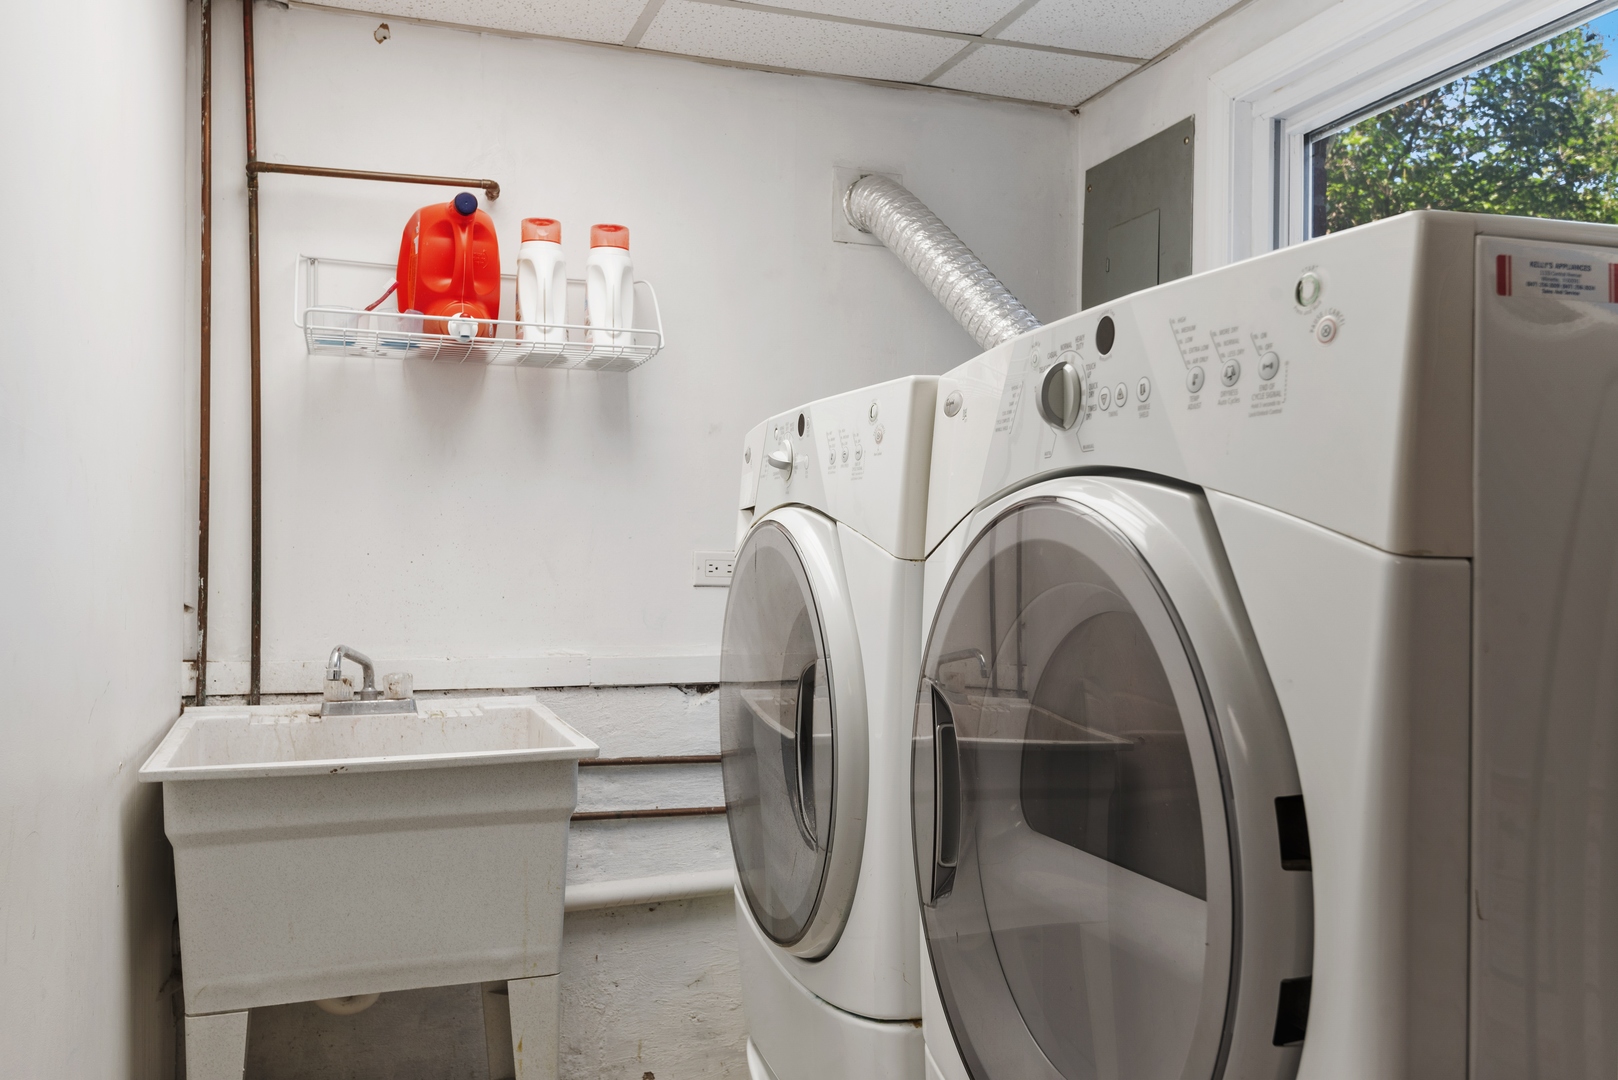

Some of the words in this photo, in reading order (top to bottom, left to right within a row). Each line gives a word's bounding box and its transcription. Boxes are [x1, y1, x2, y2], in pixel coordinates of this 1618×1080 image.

[1530, 261, 1554, 270] KELLY'S
[1555, 262, 1592, 272] APPLIANCES
[1181, 324, 1196, 333] MEDIUM
[1219, 327, 1231, 336] MORE
[1060, 341, 1073, 351] NORMAL
[1188, 346, 1200, 354] EXTRA
[1085, 362, 1097, 371] TOUCH
[1088, 382, 1099, 391] QUICK
[1258, 383, 1268, 392] END
[1220, 388, 1238, 398] DRYNESS
[1251, 392, 1265, 401] CYCLE
[1265, 390, 1283, 399] SIGNAL
[1087, 403, 1098, 412] TIMED
[1187, 402, 1202, 410] ADJUST
